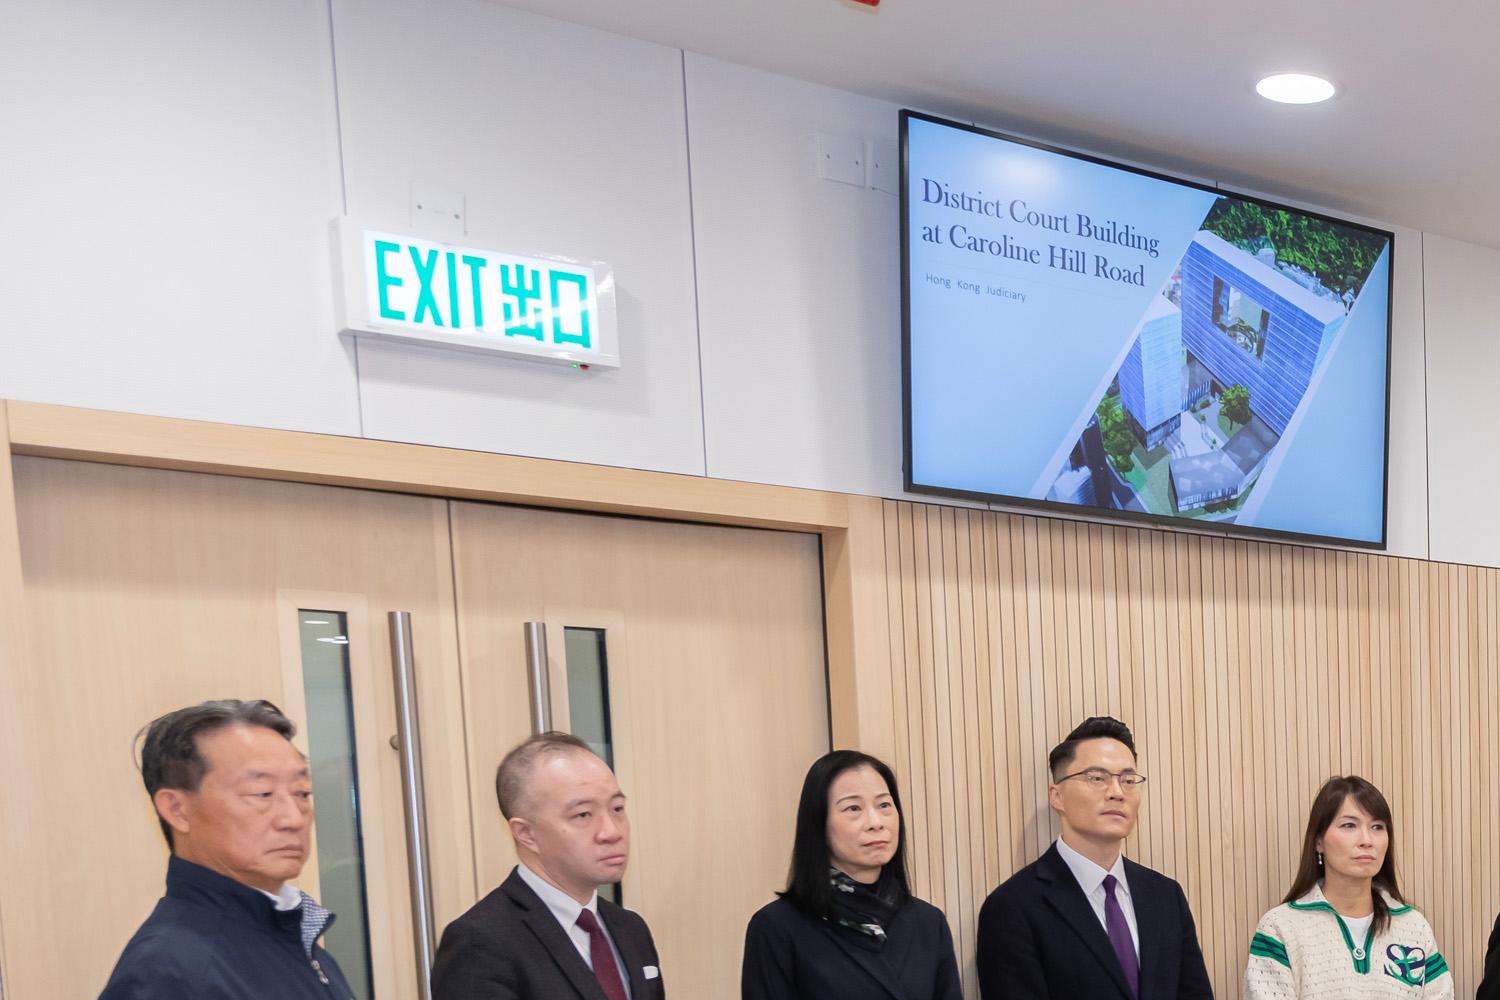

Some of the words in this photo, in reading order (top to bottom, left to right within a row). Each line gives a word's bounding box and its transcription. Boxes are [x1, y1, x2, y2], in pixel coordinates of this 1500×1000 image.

[921, 177, 1003, 219] District
[1009, 198, 1071, 233] Court
[1076, 212, 1160, 258] Building
[921, 224, 944, 245] at
[949, 223, 1041, 265] Caroline
[1048, 243, 1087, 274] Hill
[1093, 254, 1146, 287] Road
[925, 273, 951, 289] Hong
[957, 279, 981, 295] Kong
[985, 284, 1028, 304] Judiciary
[374, 239, 488, 330] EXIT
[499, 263, 592, 349] 出口
